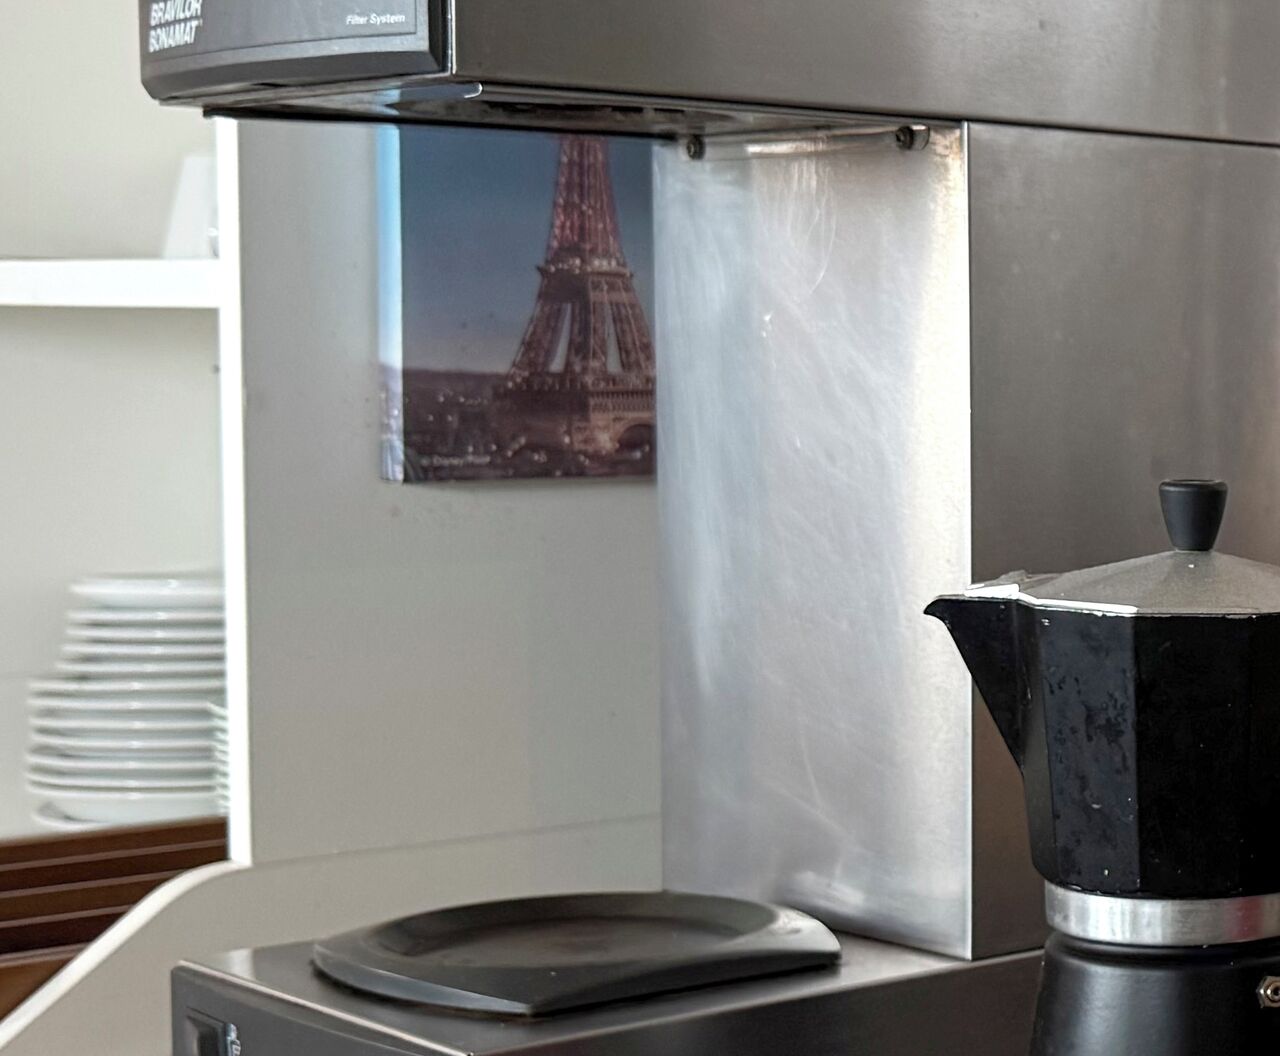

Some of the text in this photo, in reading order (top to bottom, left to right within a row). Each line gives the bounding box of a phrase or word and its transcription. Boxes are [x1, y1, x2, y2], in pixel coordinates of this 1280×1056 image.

[149, 0, 203, 27] BRAVILOR
[369, 12, 406, 26] System
[148, 19, 199, 53] BONAMAT
